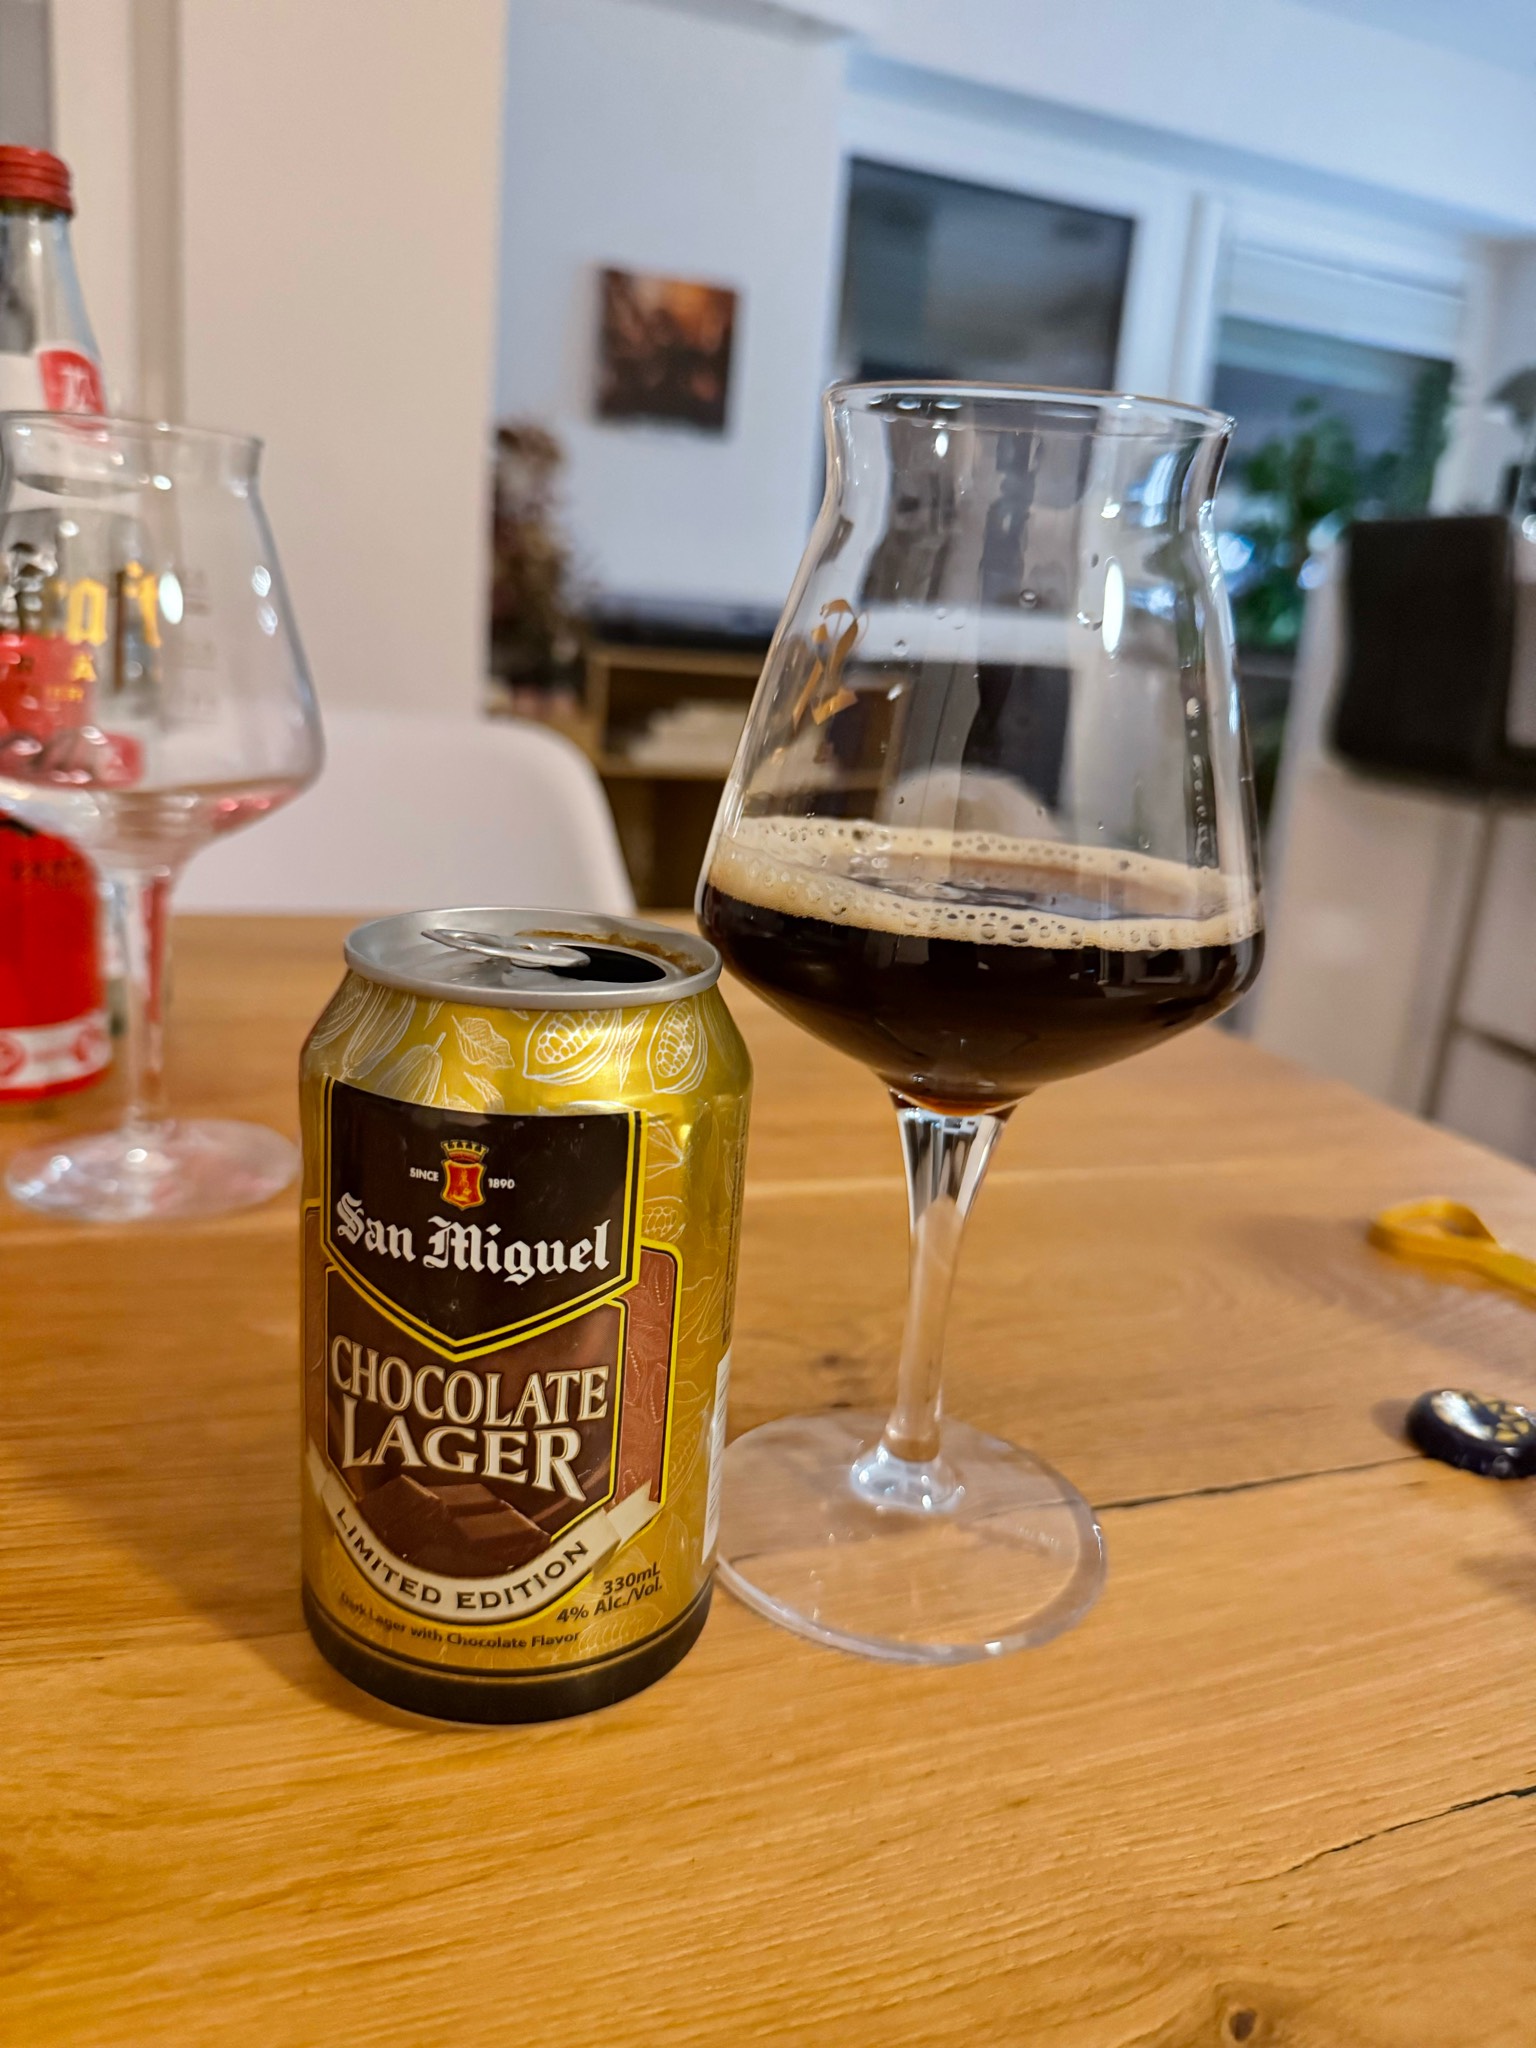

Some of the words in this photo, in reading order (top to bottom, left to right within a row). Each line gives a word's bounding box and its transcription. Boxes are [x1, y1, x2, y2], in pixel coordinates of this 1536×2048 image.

[409, 1166, 439, 1183] SINCE
[488, 1177, 516, 1190] 1890
[336, 1191, 417, 1263] San
[422, 1215, 612, 1286] Miguel
[331, 1334, 610, 1427] CHOCOLATE
[341, 1392, 587, 1502] LAGER
[337, 1507, 443, 1605] LIMITED
[456, 1540, 590, 1610] EDITION
[602, 1562, 661, 1596] 330mL
[368, 1608, 408, 1635] Lager
[409, 1625, 444, 1643] with
[446, 1631, 528, 1649] Chocolate
[530, 1632, 580, 1648] Flavor
[556, 1604, 590, 1623] 4%
